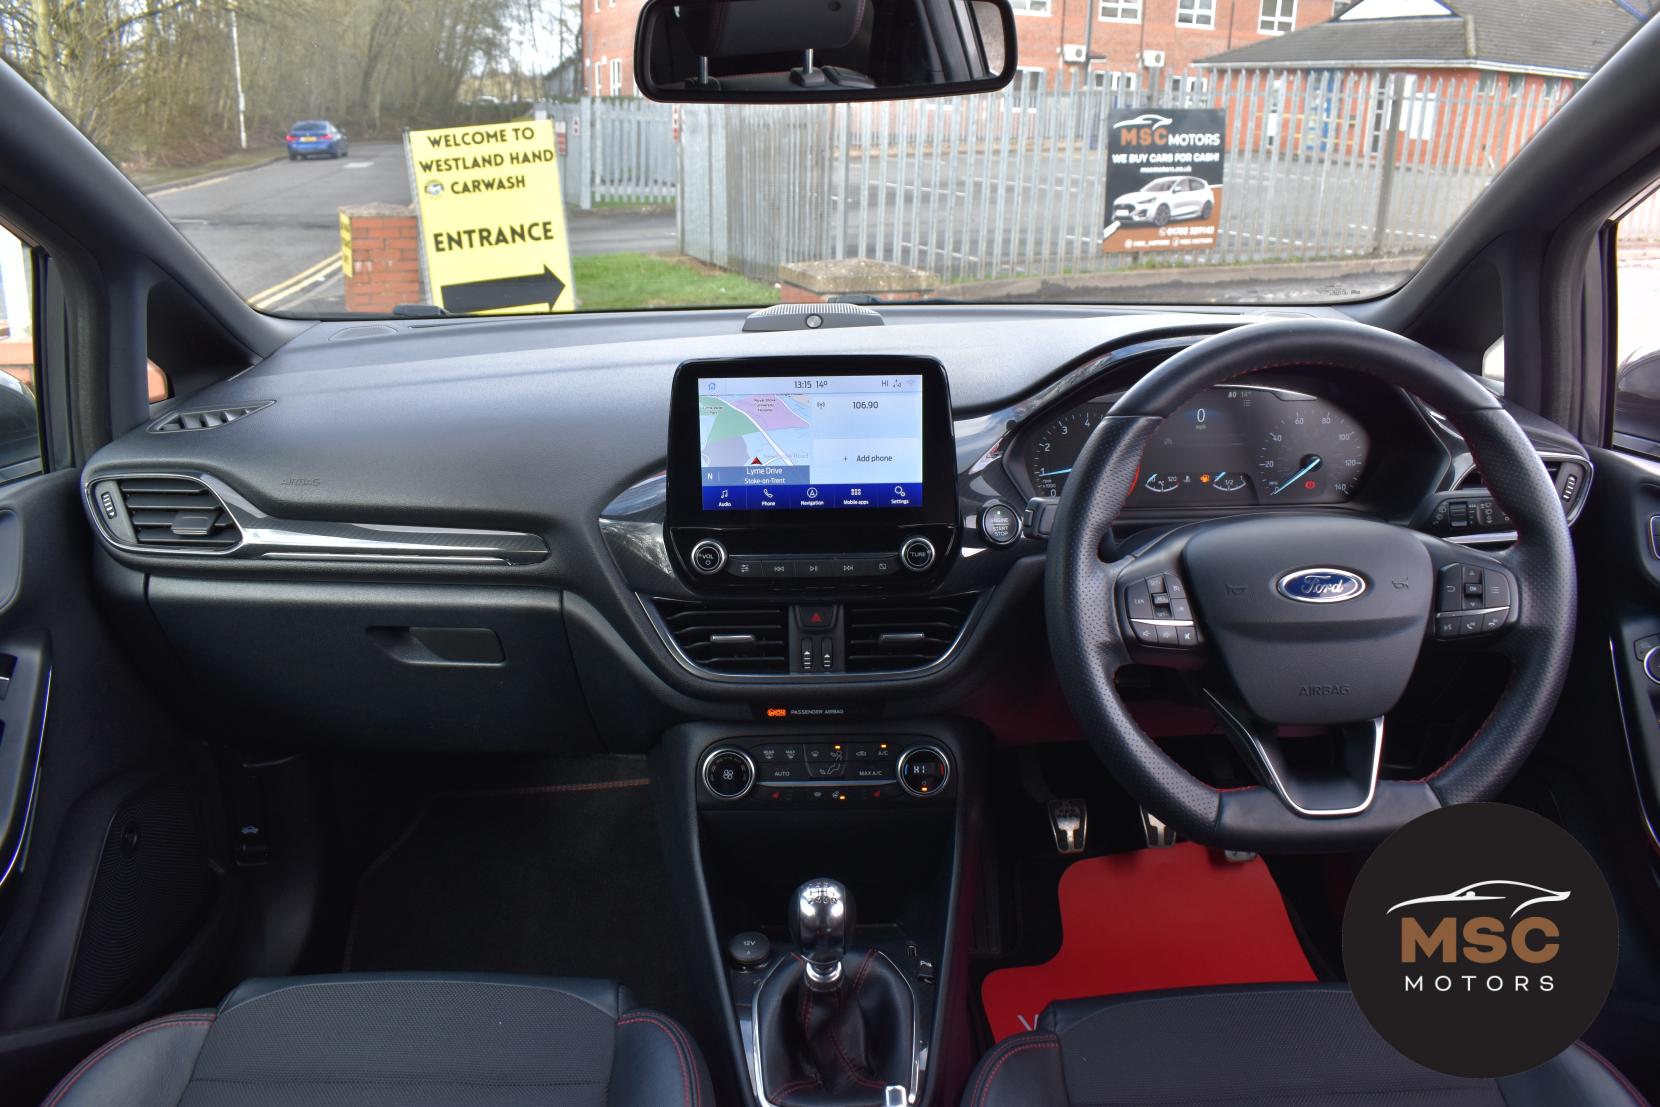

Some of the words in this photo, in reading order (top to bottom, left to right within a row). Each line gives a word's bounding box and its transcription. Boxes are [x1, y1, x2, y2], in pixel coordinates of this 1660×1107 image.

[427, 129, 508, 148] WELCOME
[512, 127, 535, 141] TO
[1120, 128, 1168, 146] MSC
[1168, 133, 1220, 146] MOTORS
[419, 153, 504, 173] WESTLAND
[510, 149, 554, 165] HAND
[1112, 153, 1127, 164] WE
[1129, 153, 1148, 164] BUY
[1149, 153, 1173, 163] CARS
[1174, 153, 1192, 162] FOR
[1193, 152, 1220, 162] CASH!
[451, 175, 526, 194] CARWASH
[433, 221, 554, 252] ENTRANCE
[853, 401, 879, 409] 106.90
[1197, 408, 1205, 422] 0
[1084, 419, 1090, 427] 4
[1295, 417, 1304, 425] 60
[1061, 426, 1068, 435] 3
[1044, 443, 1050, 452] 2
[871, 455, 893, 463] phone
[746, 467, 764, 476] Lyme
[765, 467, 783, 475] Drive
[280, 478, 320, 487] AIRBAG
[744, 477, 785, 485] Stoke-on-Trent
[1301, 575, 1343, 593] Ford
[1298, 685, 1350, 696] AIRBAG
